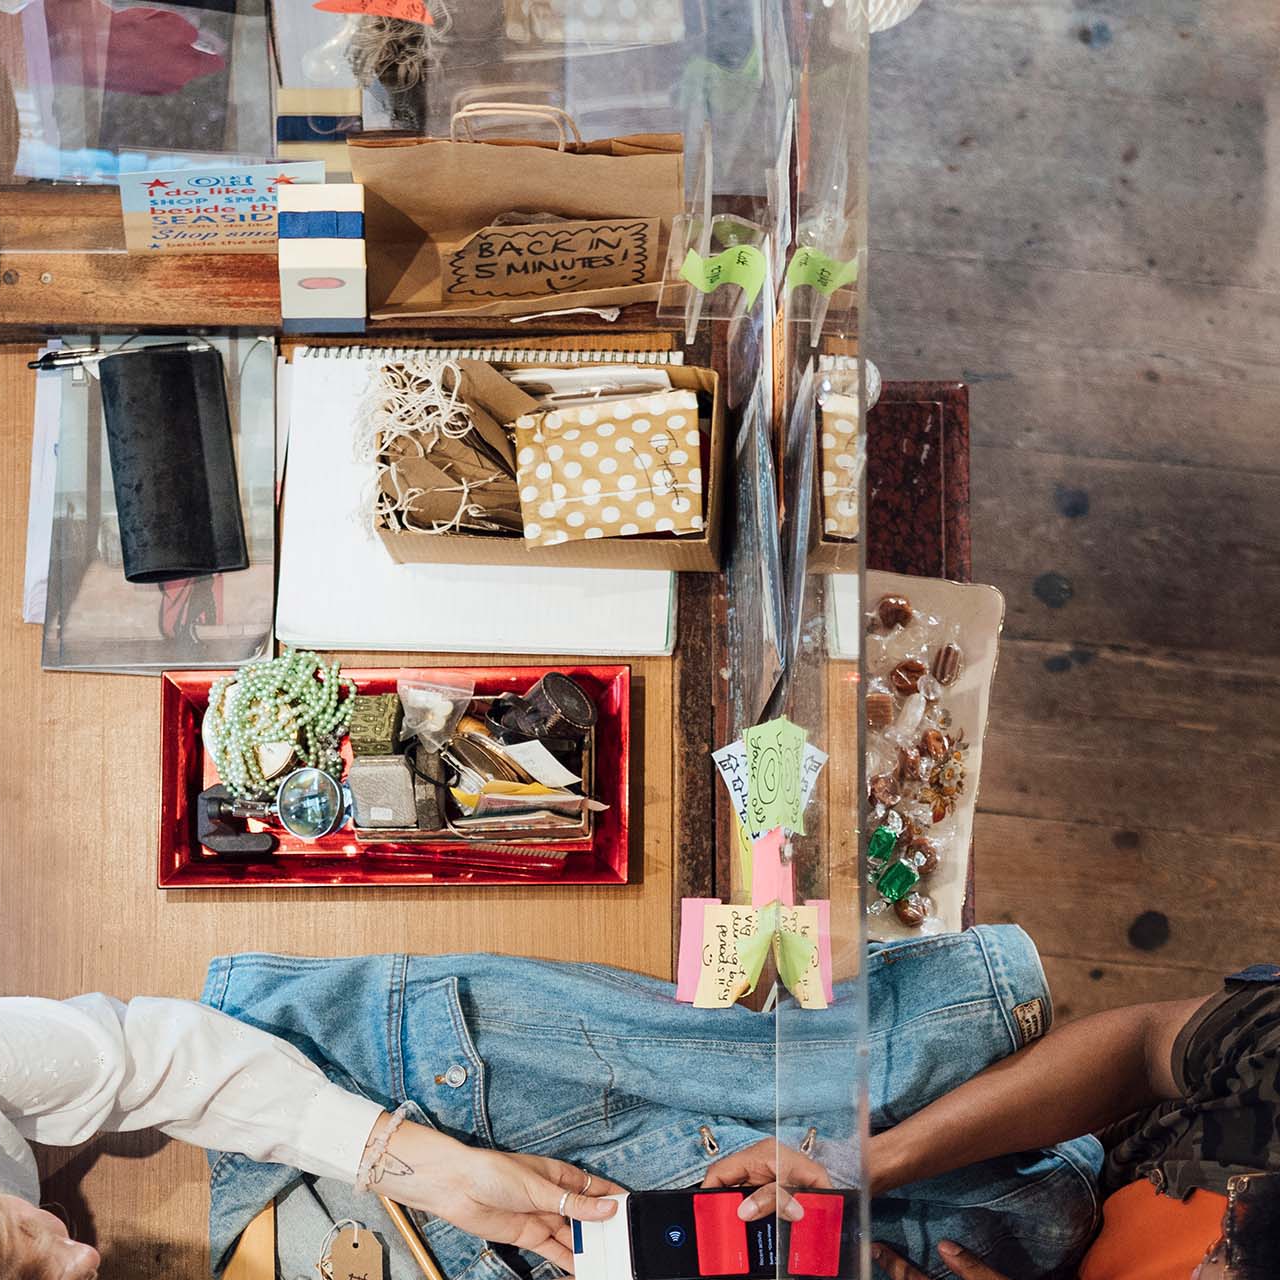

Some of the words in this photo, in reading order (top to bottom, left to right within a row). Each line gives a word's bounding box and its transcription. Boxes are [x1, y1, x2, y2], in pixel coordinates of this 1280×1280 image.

[165, 188, 199, 197] do
[209, 186, 256, 195] like
[150, 198, 208, 206] SHOP
[150, 205, 236, 215] beside
[152, 229, 219, 240] Shop
[478, 238, 576, 258] BACK
[588, 237, 622, 251] IN
[475, 263, 498, 279] 5
